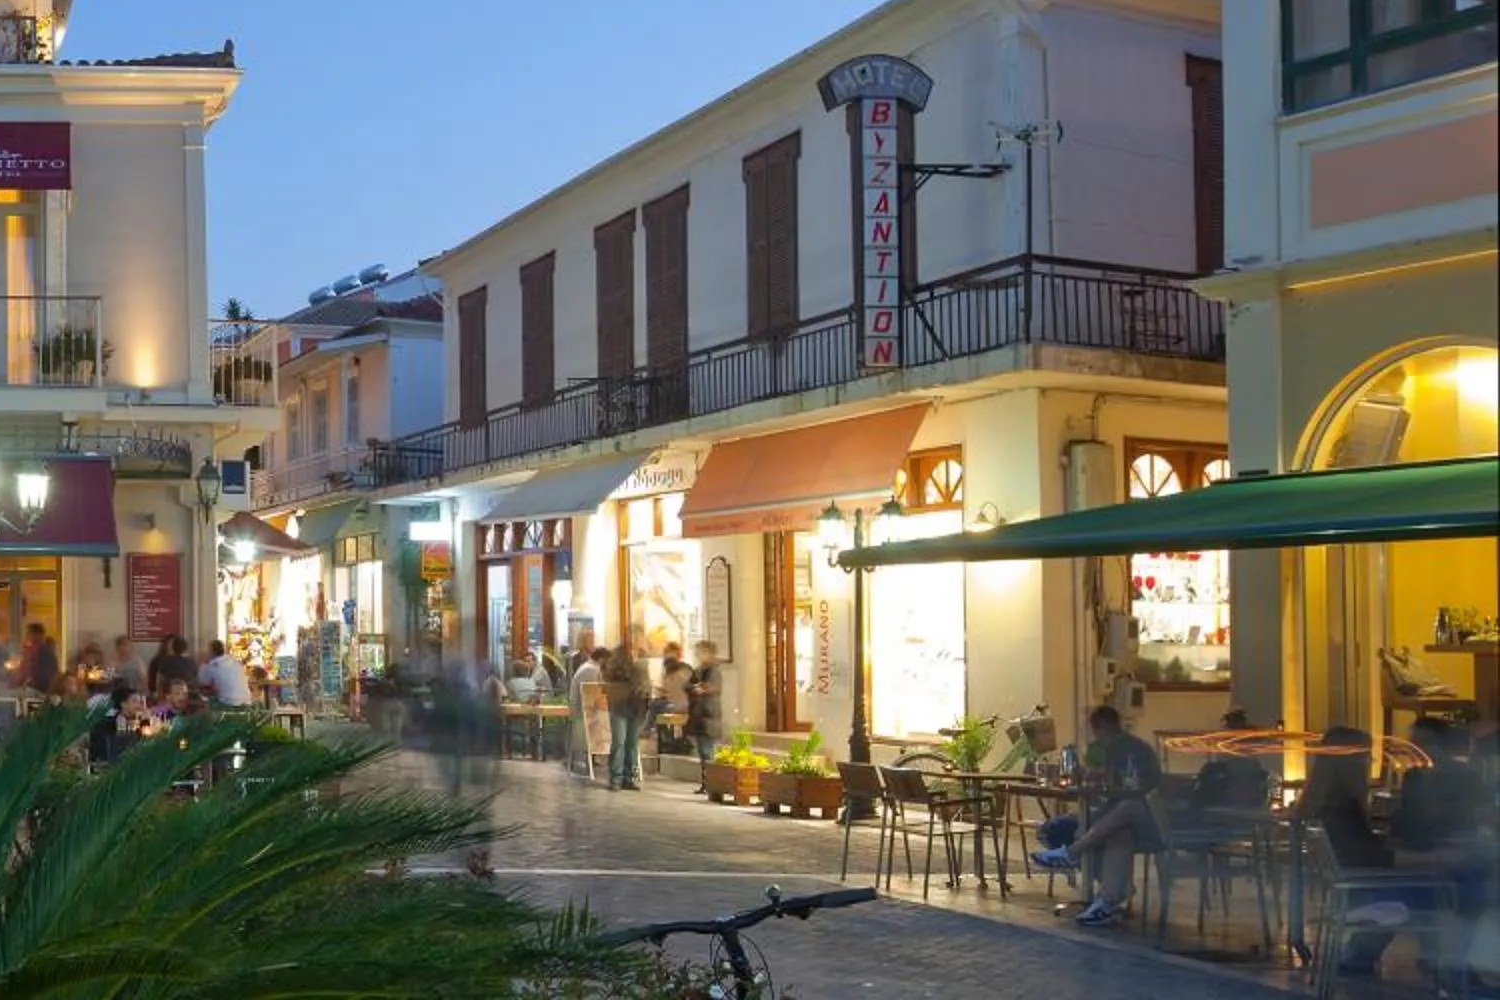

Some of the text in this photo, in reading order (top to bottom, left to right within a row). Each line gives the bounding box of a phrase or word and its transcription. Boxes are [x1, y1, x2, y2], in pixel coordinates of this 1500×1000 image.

[830, 60, 930, 102] HOTEL
[870, 101, 893, 364] BYZANTION
[817, 599, 829, 695] MURANO
